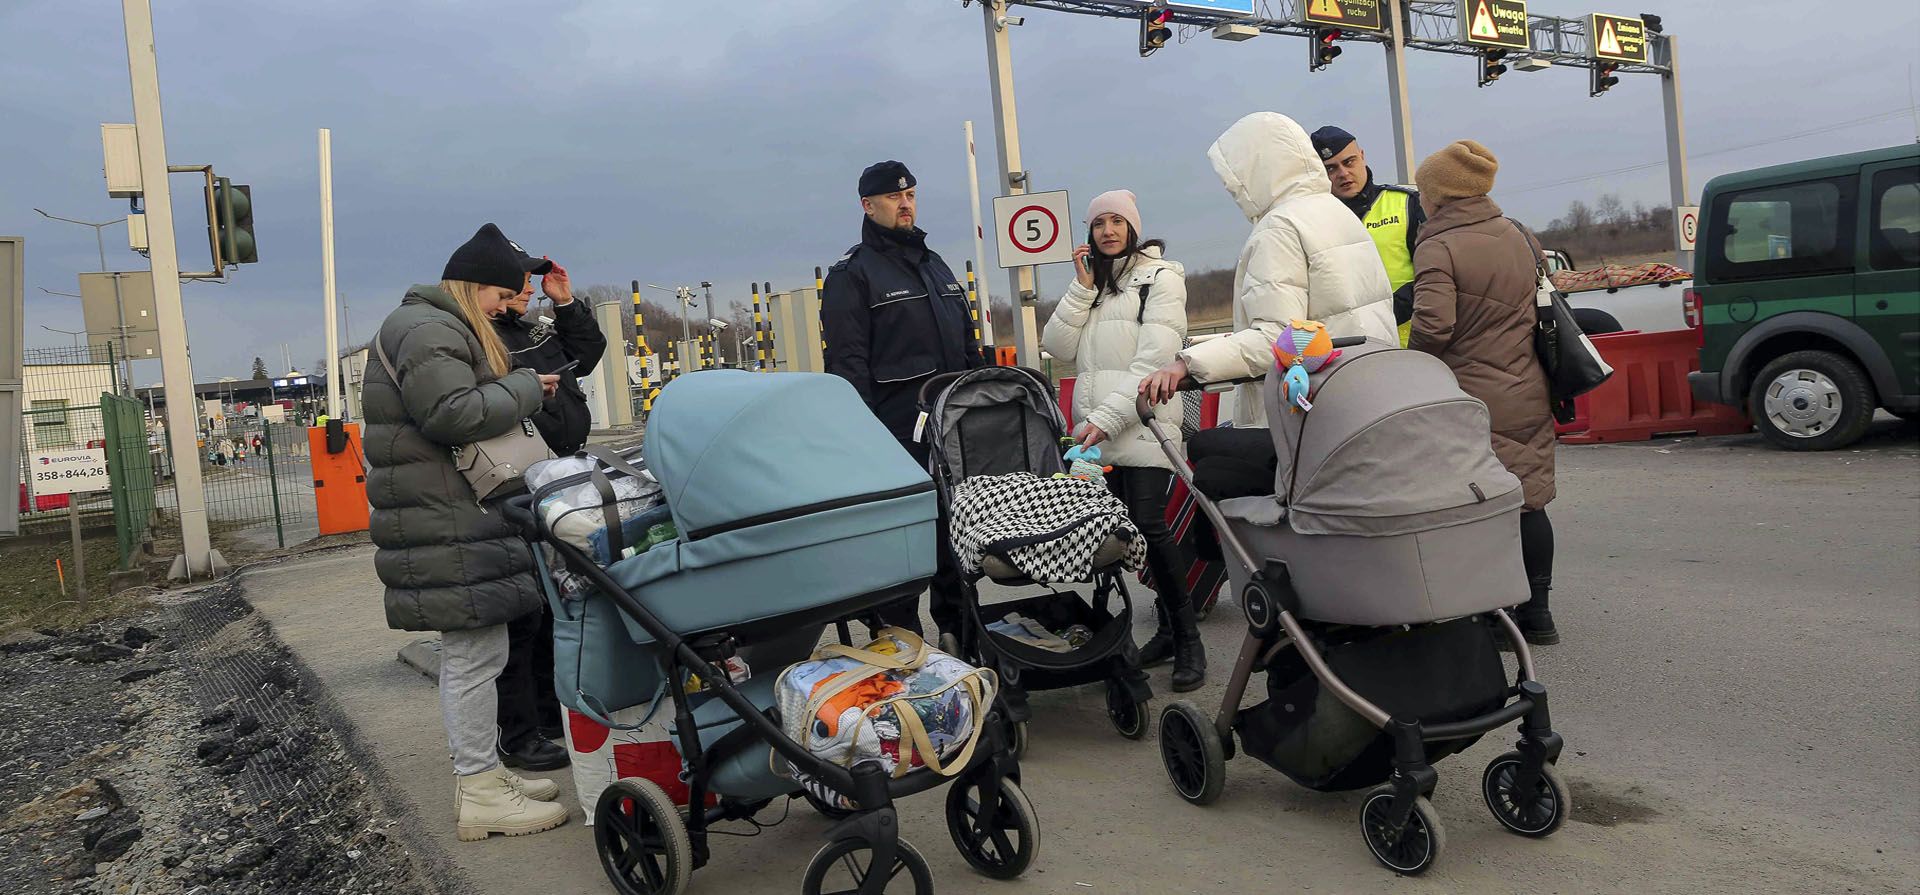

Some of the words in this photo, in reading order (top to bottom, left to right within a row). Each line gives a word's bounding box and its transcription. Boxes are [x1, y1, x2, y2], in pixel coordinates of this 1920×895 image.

[1338, 0, 1375, 8] ganizacji
[1347, 8, 1367, 17] ruchu
[1492, 4, 1524, 24] Uwaga
[1366, 215, 1400, 229] POLICJA
[1687, 221, 1694, 236] 5
[1026, 219, 1042, 242] 5
[51, 455, 92, 463] EUROVIA
[36, 467, 105, 482] 358+844,26
